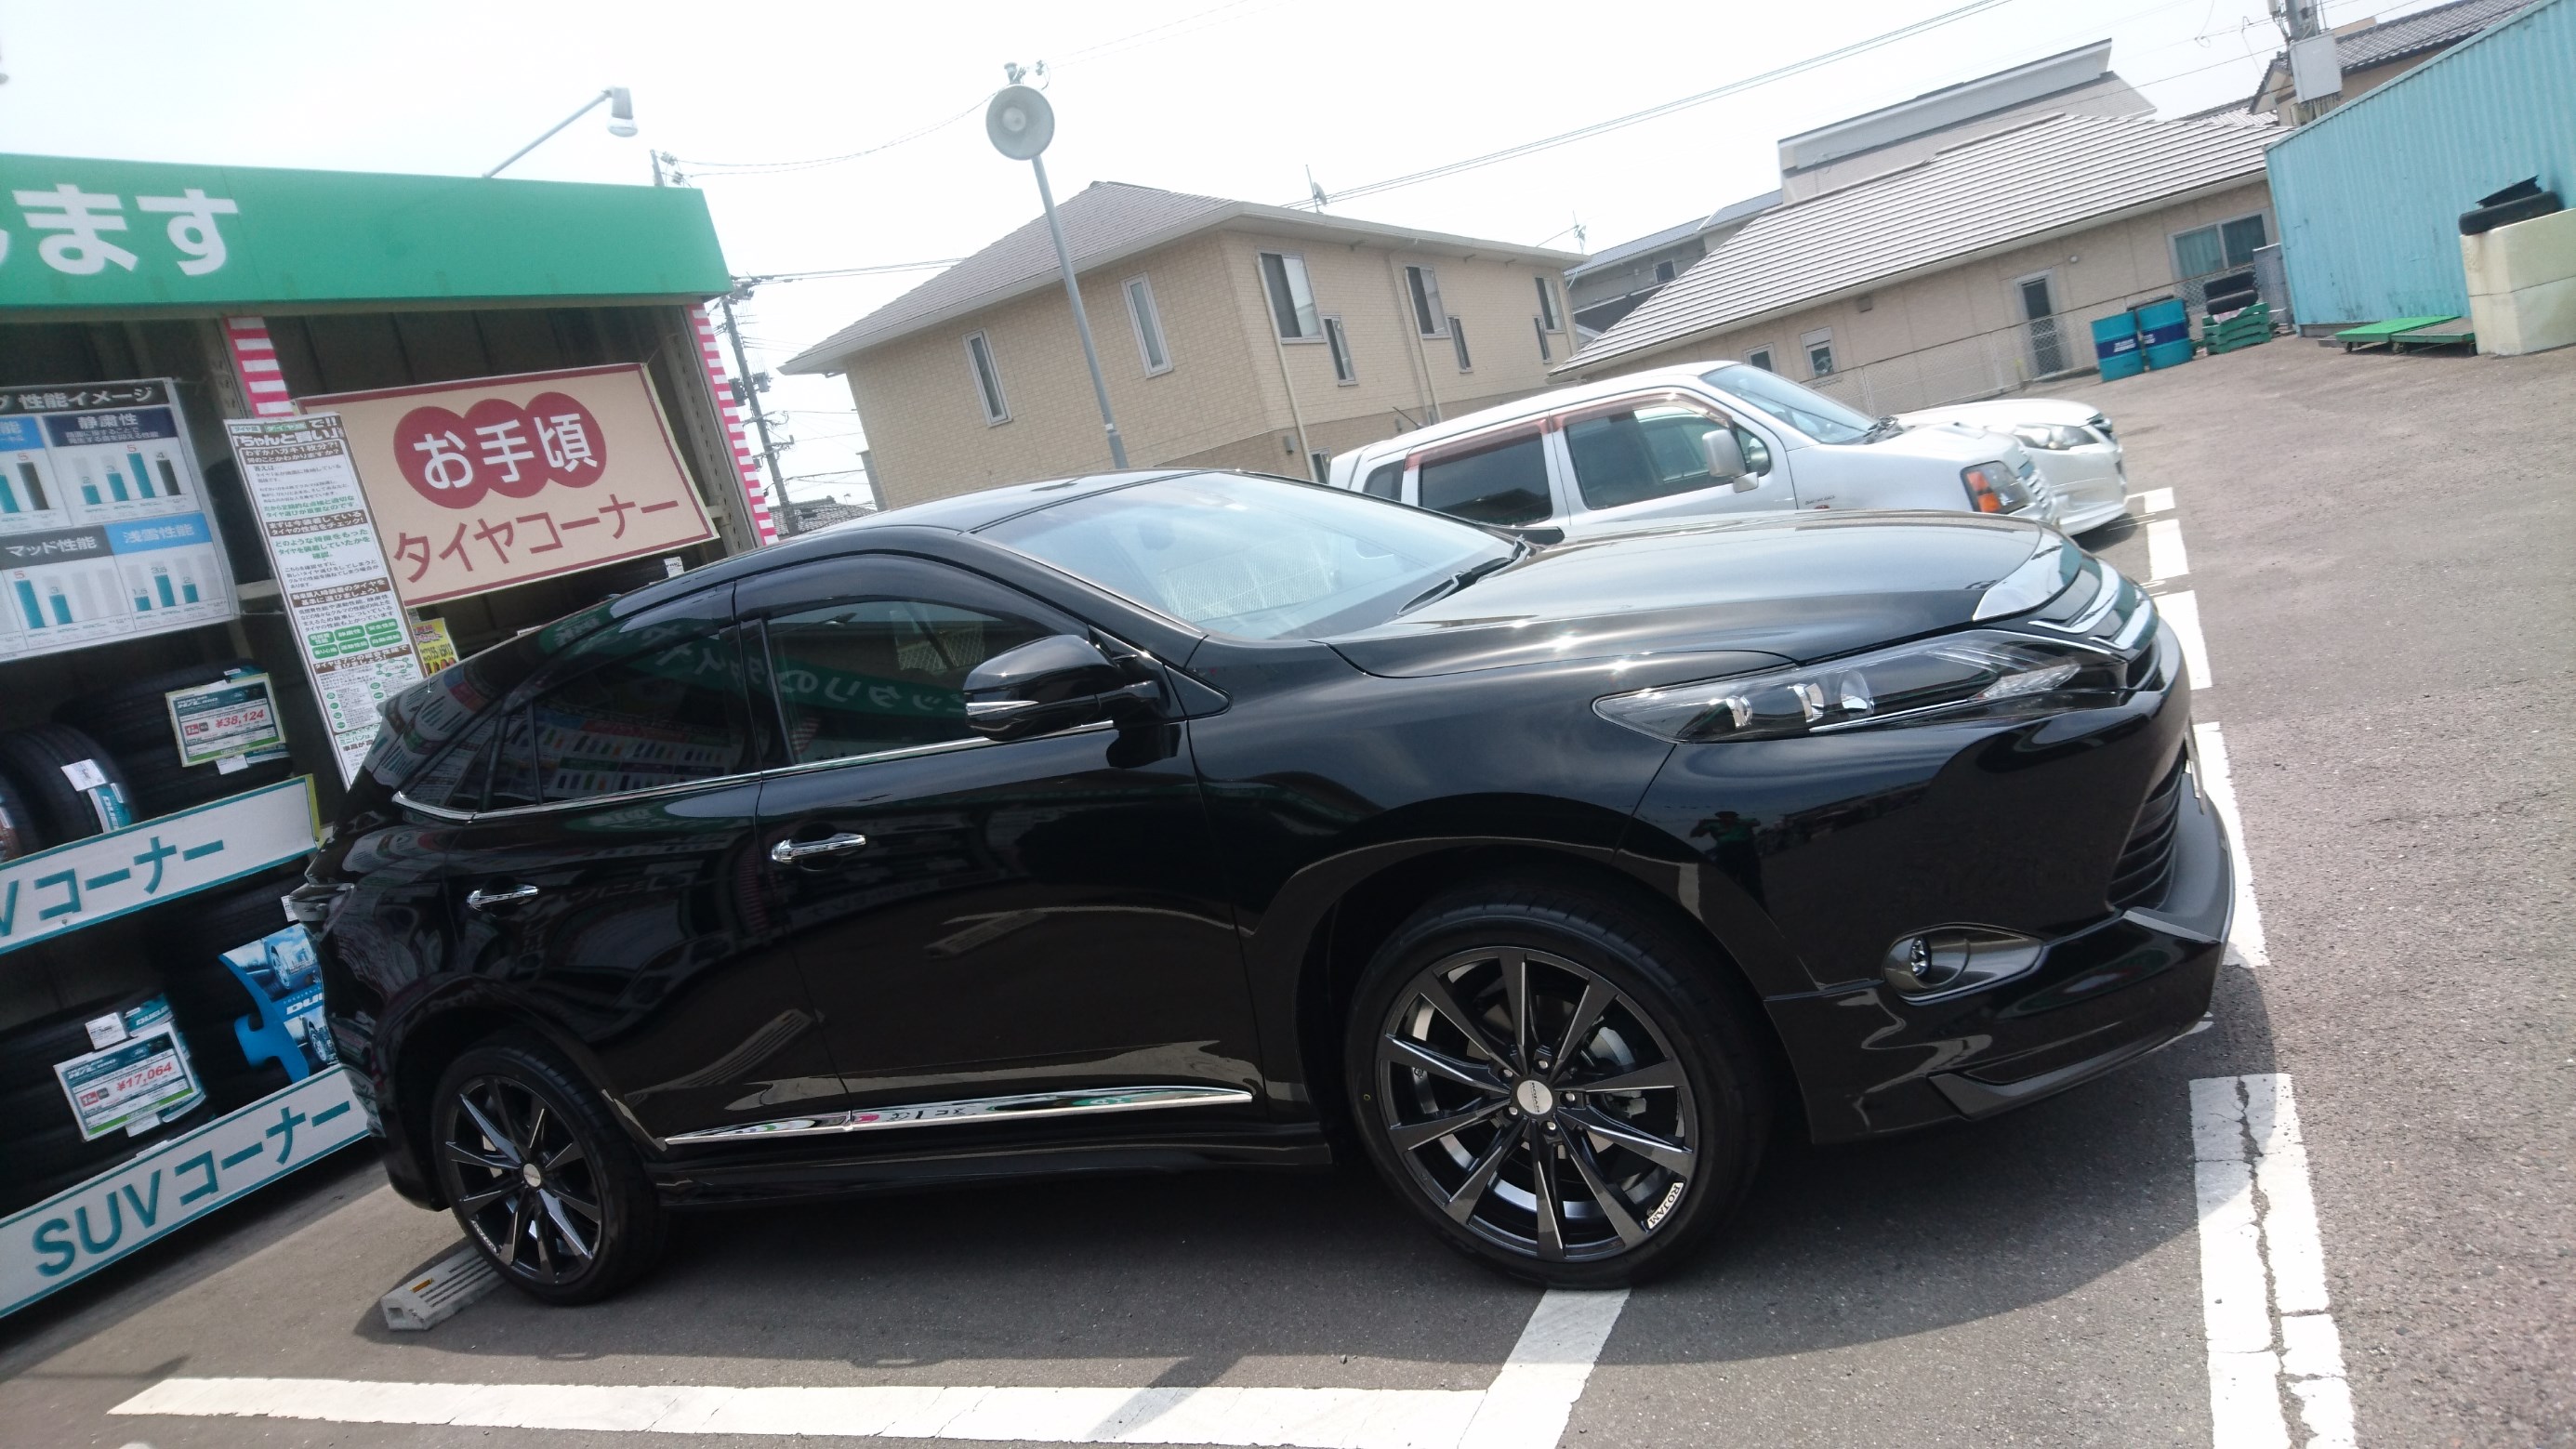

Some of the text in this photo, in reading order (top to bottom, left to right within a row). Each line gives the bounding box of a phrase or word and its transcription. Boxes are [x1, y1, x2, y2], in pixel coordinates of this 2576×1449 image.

[0, 183, 239, 275] ます
[19, 387, 152, 409] 性能イメージ
[414, 413, 597, 489] お手頃
[6, 536, 97, 556] マッド性能
[394, 494, 679, 583] タイヤコーナー
[14, 570, 25, 578] 5
[215, 709, 264, 728] ¥38,124
[116, 1061, 172, 1091] ¥17,064
[33, 1100, 350, 1277] SUVコーナー
[1649, 1185, 1680, 1224] ROJAM
